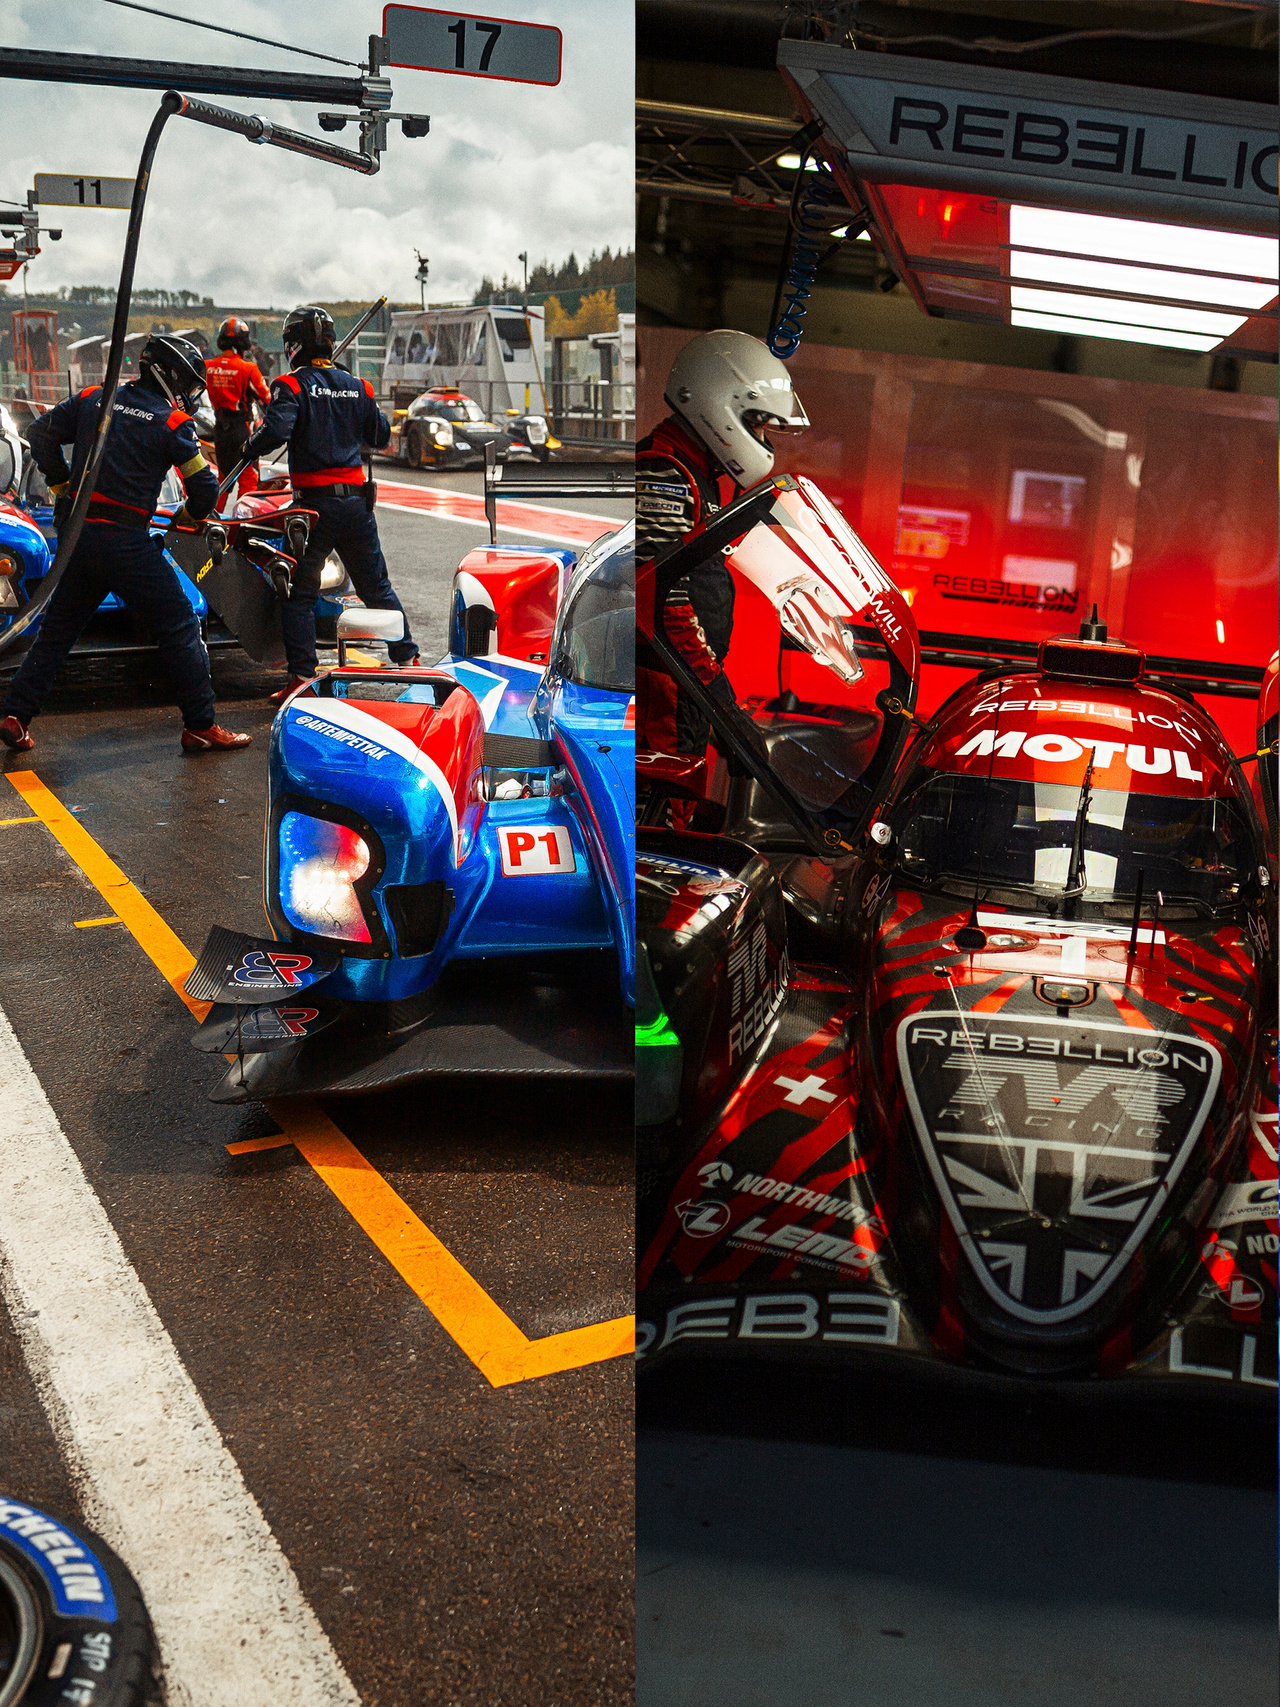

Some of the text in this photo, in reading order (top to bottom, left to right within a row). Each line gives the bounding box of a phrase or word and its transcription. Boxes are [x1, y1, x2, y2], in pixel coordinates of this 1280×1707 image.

[447, 19, 502, 72] 17
[73, 178, 102, 205] 11
[122, 406, 155, 422] RACING
[331, 389, 360, 399] RACING
[932, 573, 1080, 603] REBELLION
[294, 714, 392, 762] @ARTEMPETYAK
[953, 729, 1204, 783] MOTUL
[505, 831, 562, 867] P1
[910, 1027, 1208, 1074] REBELLION
[941, 1053, 1187, 1125] TVR
[937, 1108, 1164, 1139] RACING
[725, 1239, 861, 1279] MOTORSPORT CONNECTORS
[0, 1500, 105, 1602] CHELIN
